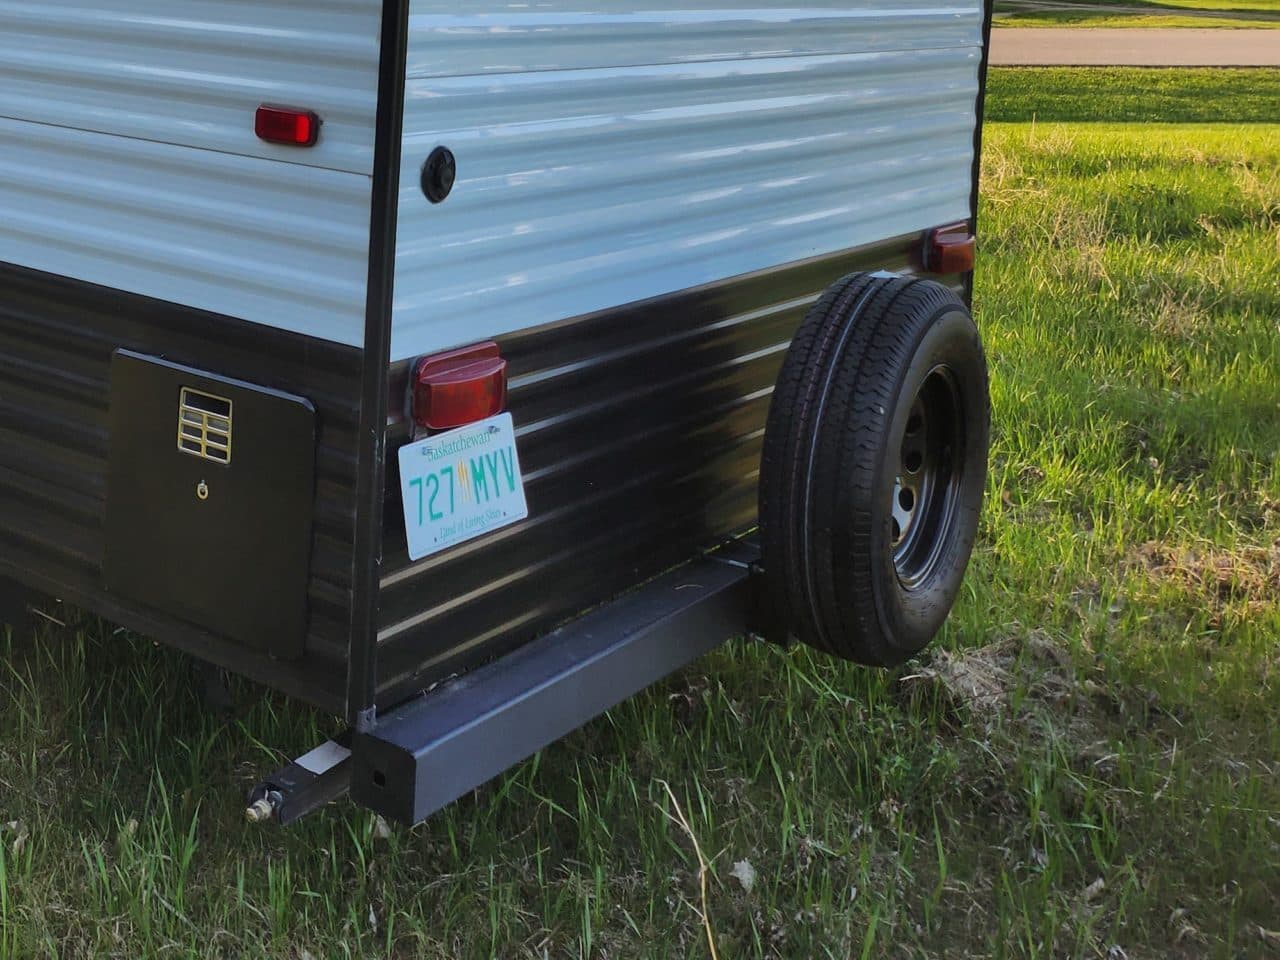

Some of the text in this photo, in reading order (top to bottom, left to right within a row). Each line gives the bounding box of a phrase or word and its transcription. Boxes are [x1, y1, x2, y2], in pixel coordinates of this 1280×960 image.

[427, 431, 491, 461] Saskatchewan
[409, 447, 516, 527] 727 MYV
